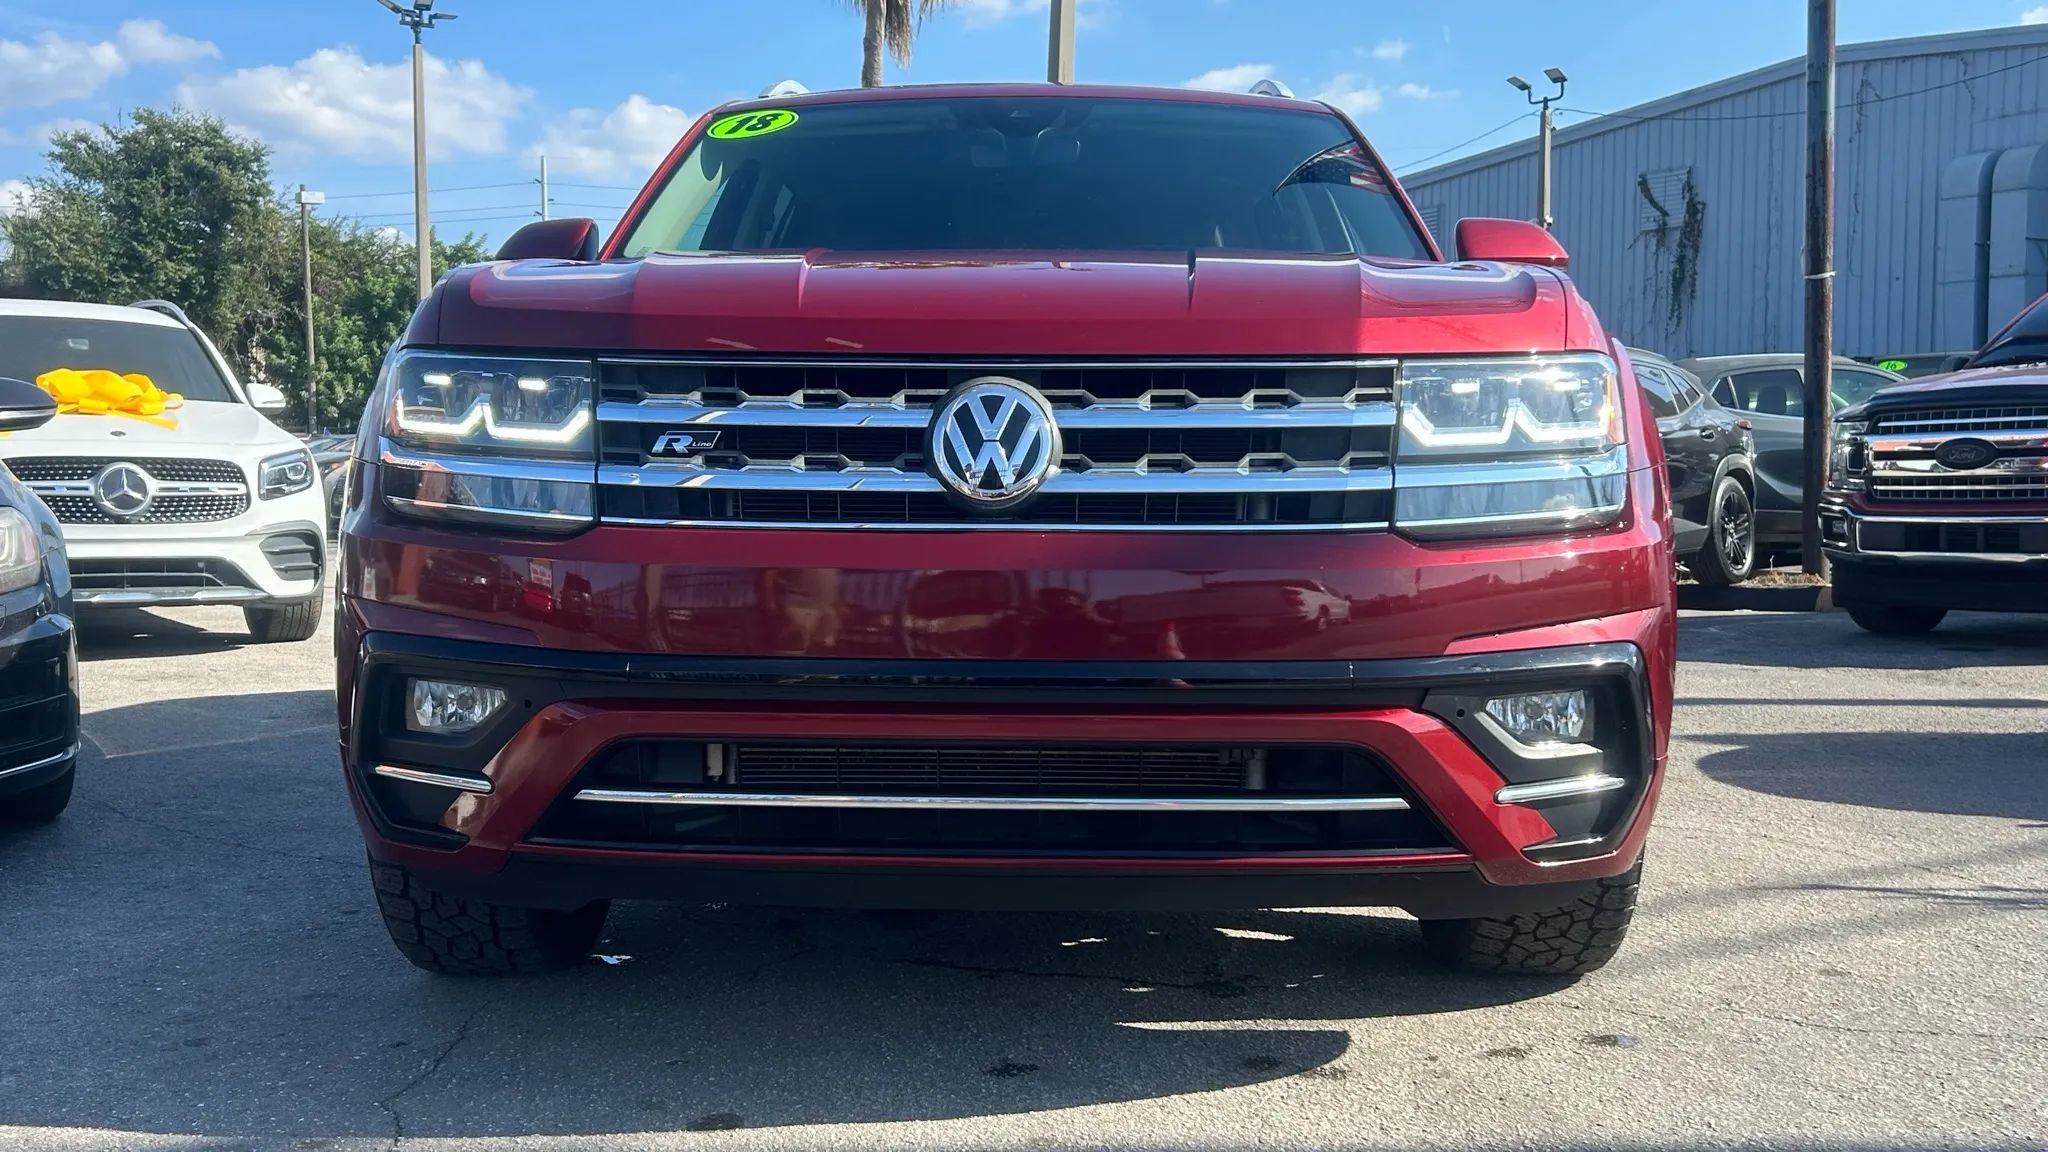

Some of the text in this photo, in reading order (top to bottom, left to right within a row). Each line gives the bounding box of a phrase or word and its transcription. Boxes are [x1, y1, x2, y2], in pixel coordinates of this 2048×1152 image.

[724, 112, 784, 135] 18
[651, 434, 693, 454] R
[1948, 447, 1977, 460] Ford
